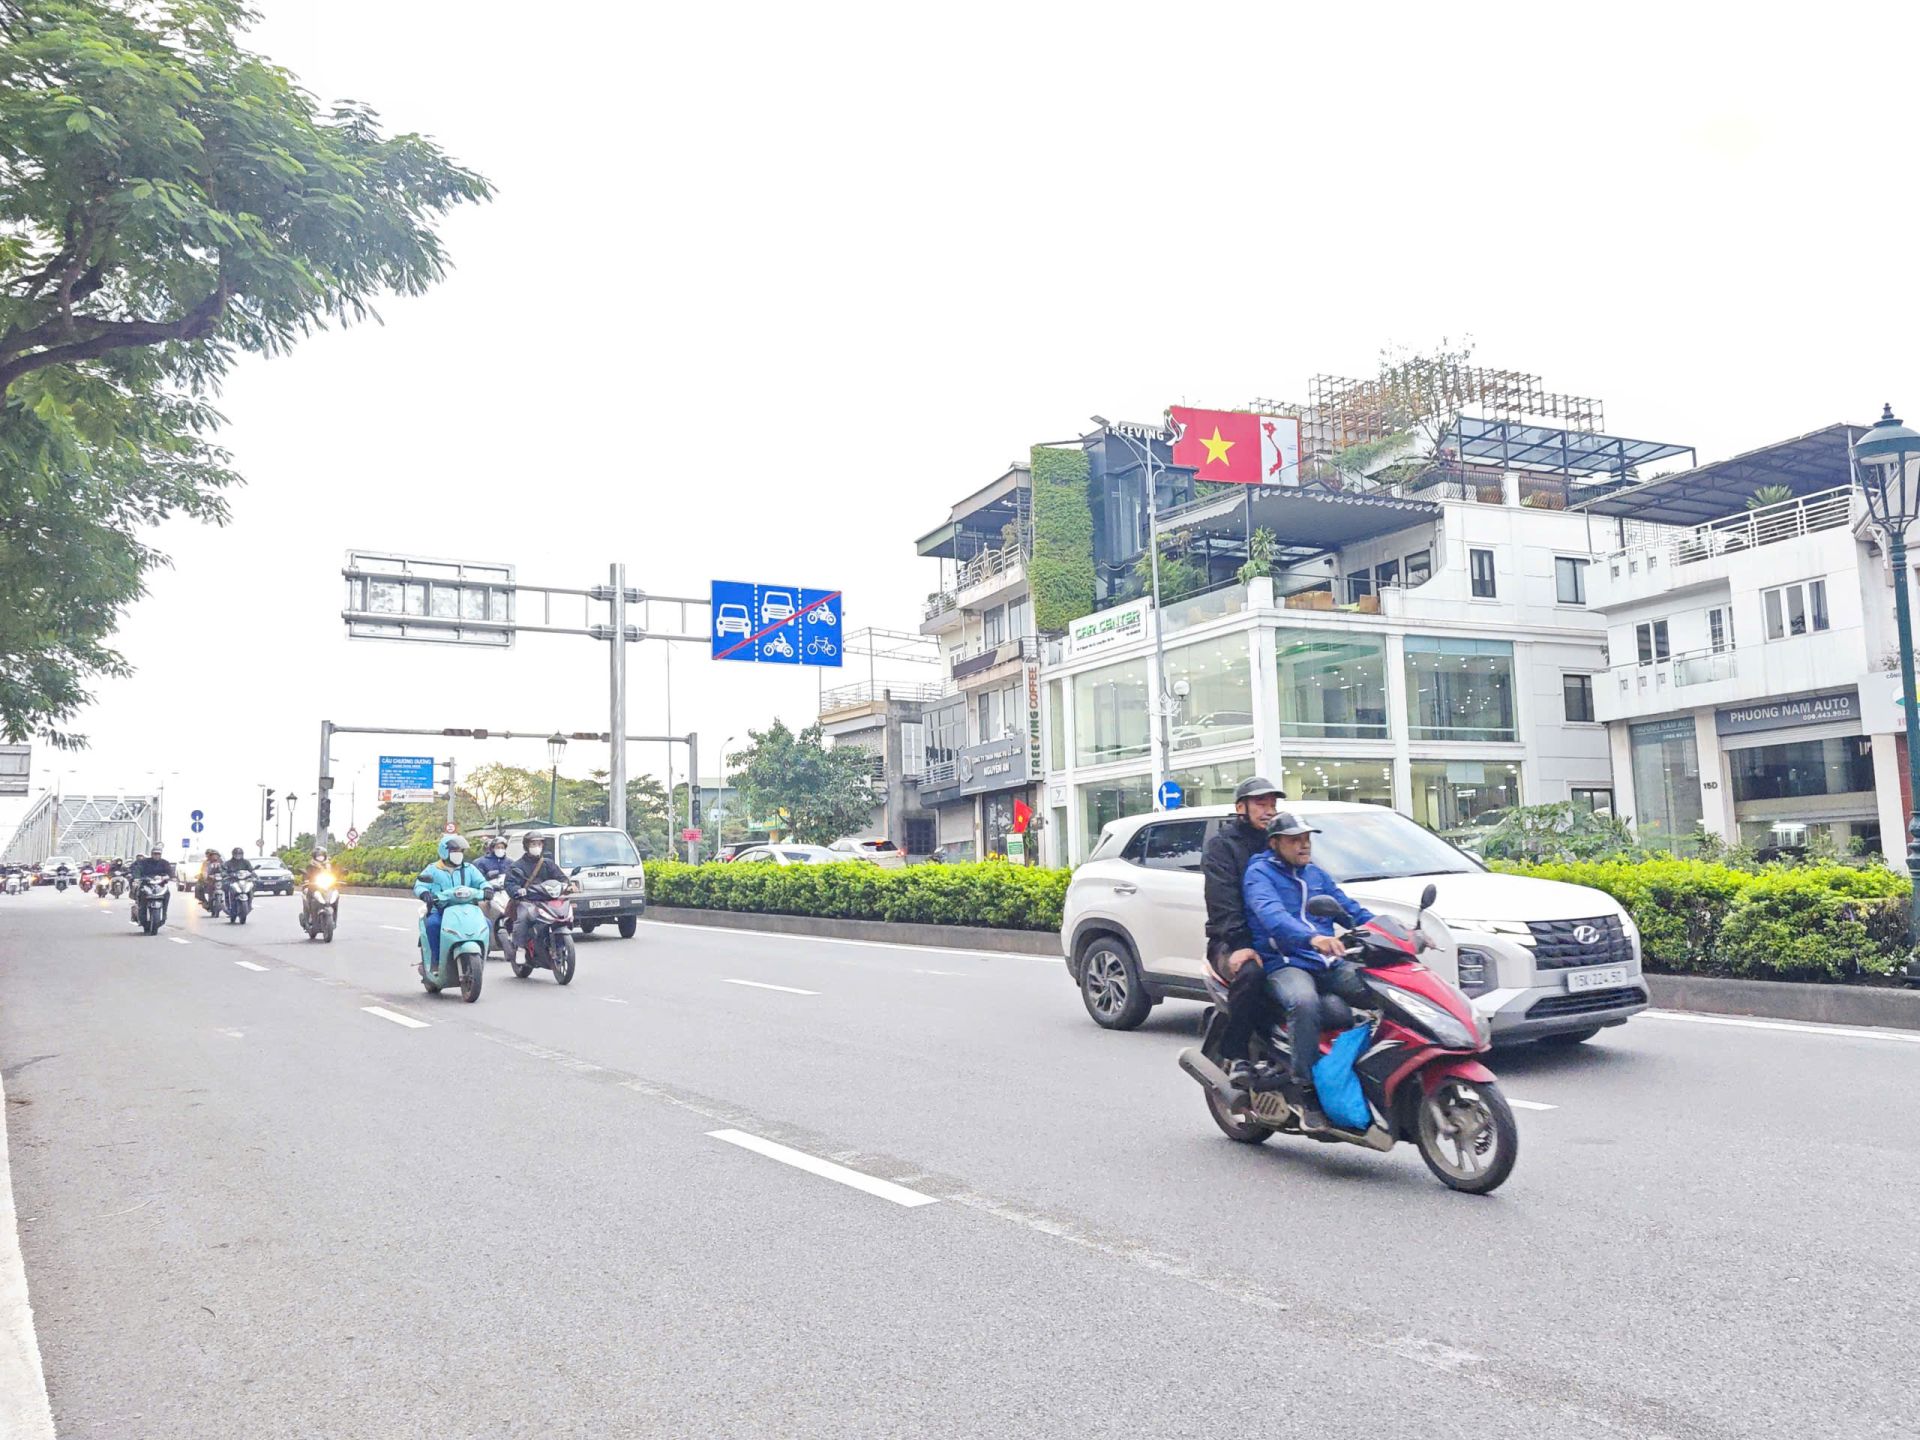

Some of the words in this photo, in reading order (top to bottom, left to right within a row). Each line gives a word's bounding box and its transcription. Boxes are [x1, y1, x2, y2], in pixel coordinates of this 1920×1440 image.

[1105, 425, 1165, 441] TREEVING
[1075, 624, 1097, 641] CAR
[1099, 611, 1141, 633] CENTER
[1028, 666, 1039, 710] COFFEE
[1730, 707, 1779, 723] PHUONG
[1782, 702, 1811, 716] NAM
[1814, 697, 1849, 712] AUTO
[1029, 711, 1041, 777] TREEVING
[1703, 781, 1718, 790] 15D
